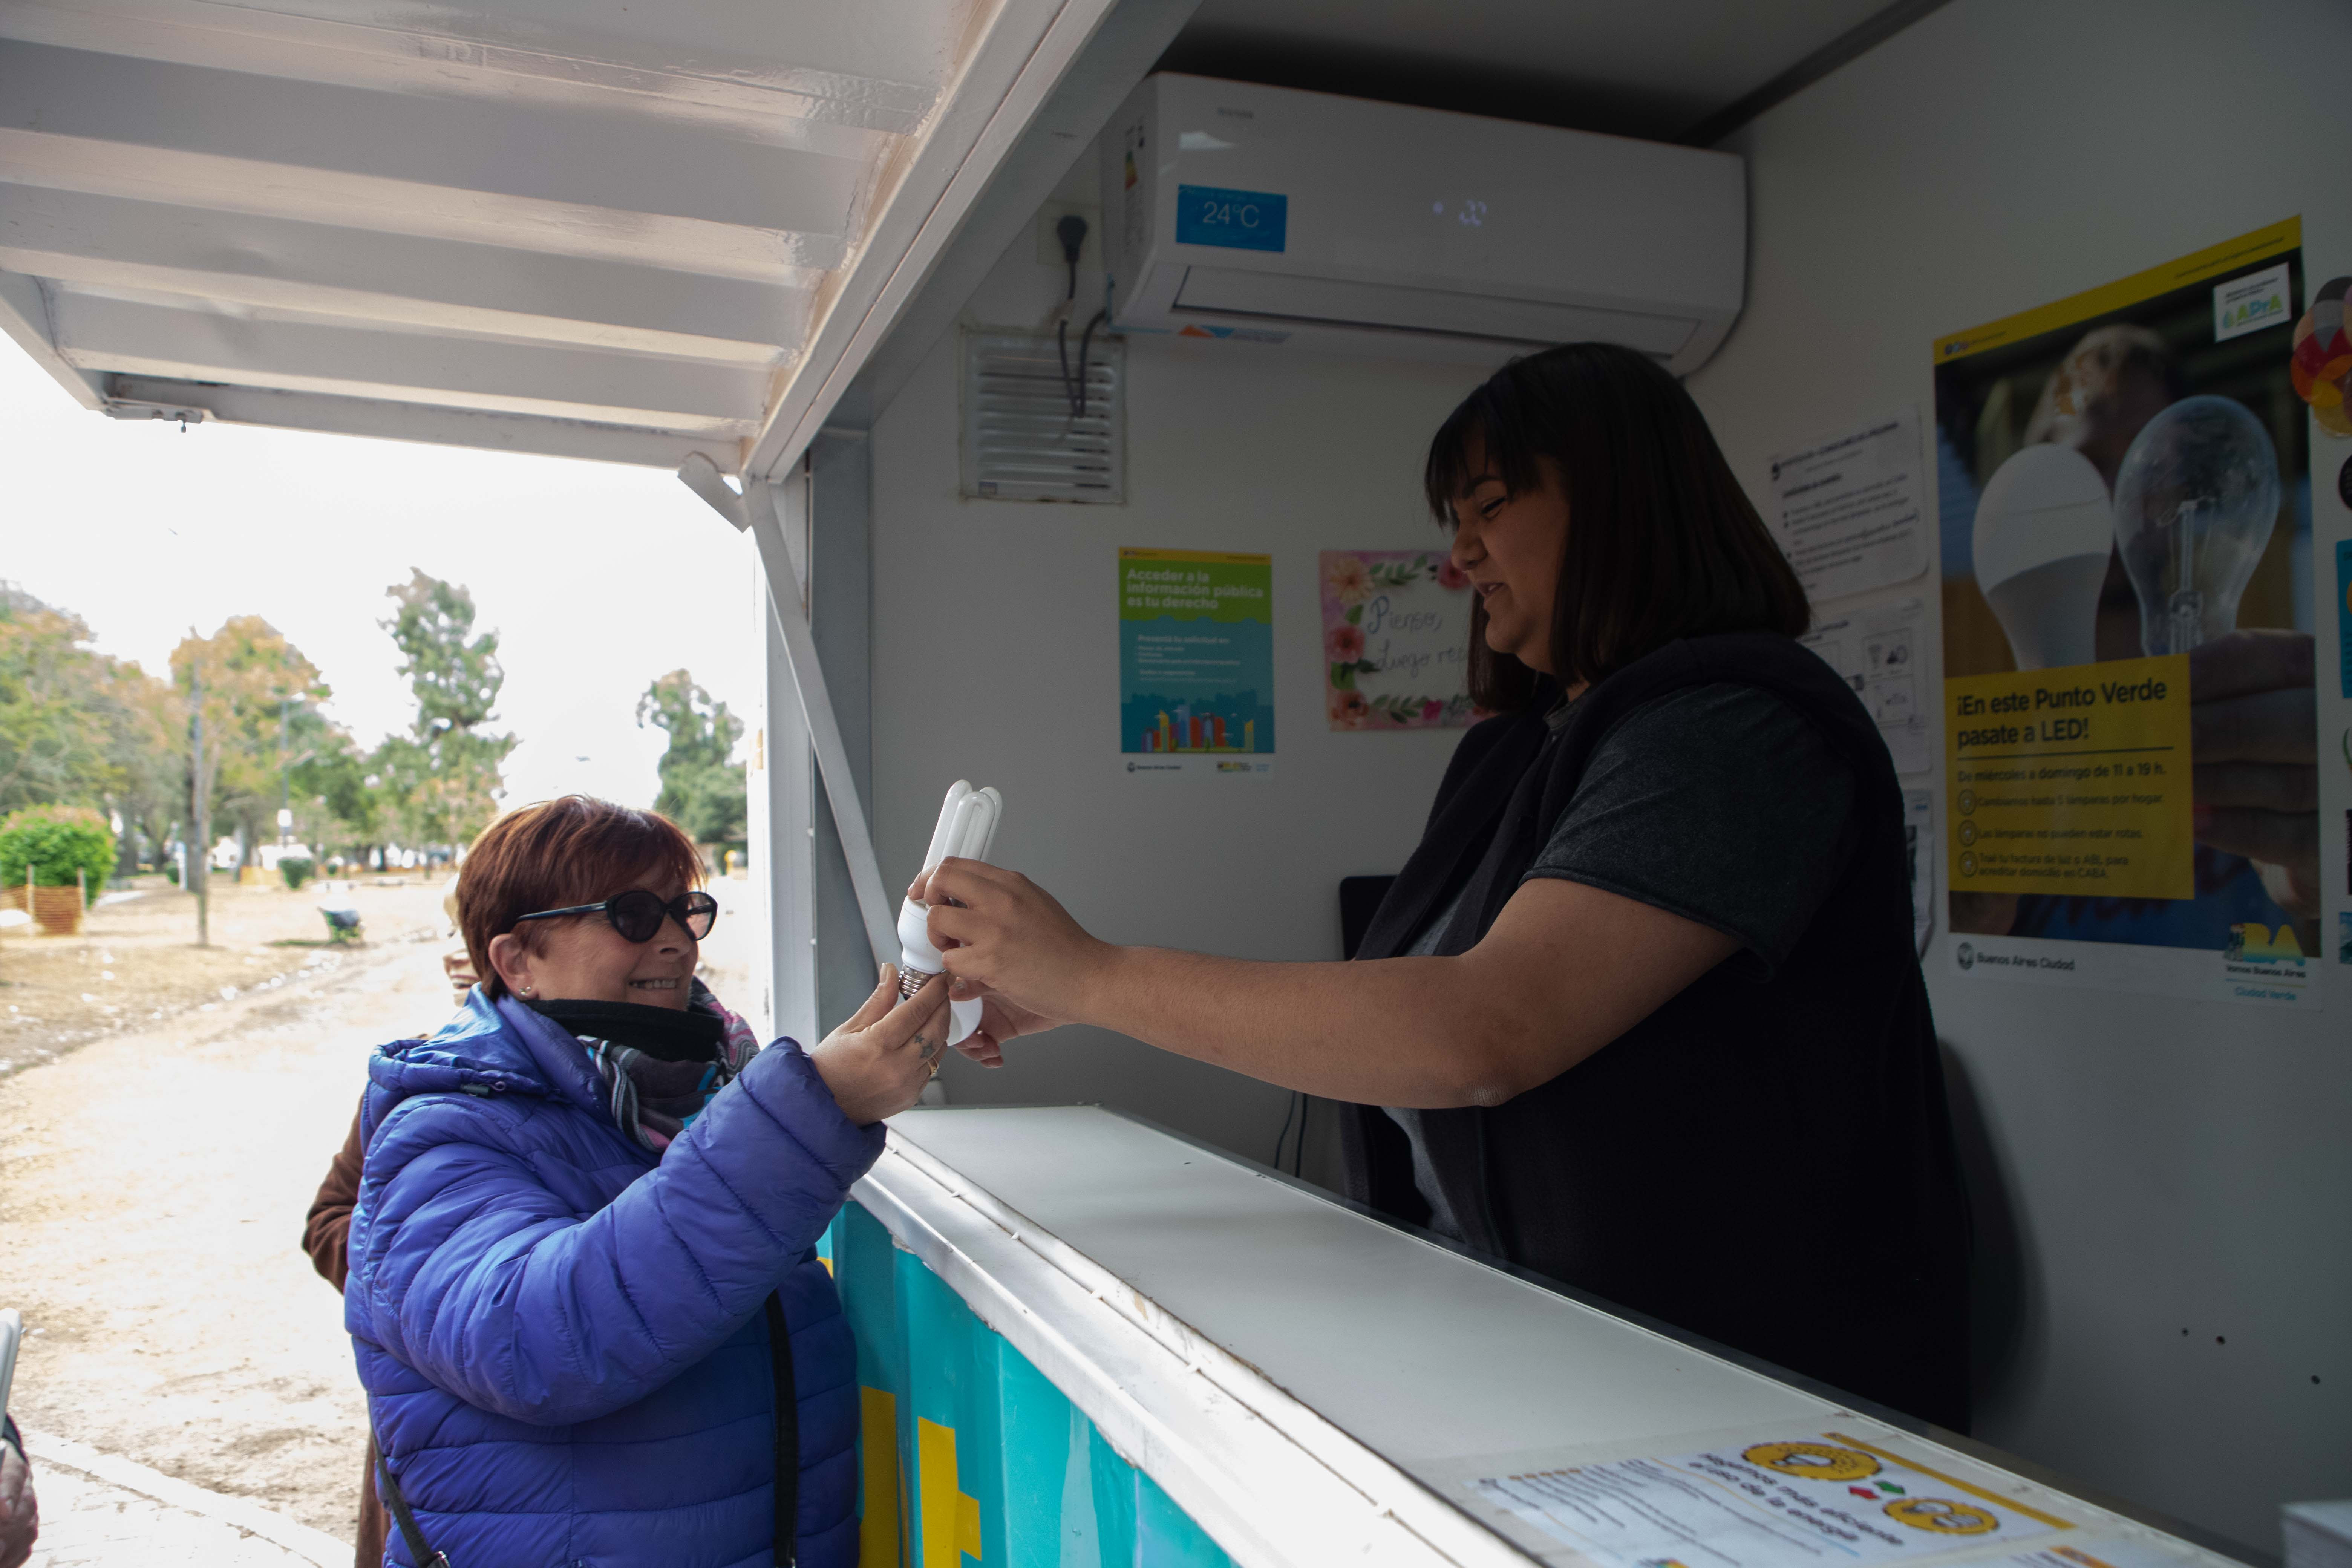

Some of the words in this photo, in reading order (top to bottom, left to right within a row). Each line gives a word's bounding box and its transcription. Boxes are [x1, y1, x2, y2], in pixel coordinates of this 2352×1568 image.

[1202, 200, 1260, 228] 24°C
[1126, 568, 1184, 582] Acceder
[1186, 572, 1195, 582] a
[1197, 570, 1210, 583] la
[1127, 581, 1210, 596] información
[1213, 585, 1263, 598] pública
[1127, 597, 1142, 606] es
[1145, 597, 1159, 607] tu
[1162, 596, 1219, 609] derecho
[1957, 694, 1985, 716] ¡En
[1991, 692, 2030, 713] este
[2035, 686, 2096, 709] Punto
[2100, 677, 2167, 704] Verde
[1958, 724, 2018, 751] pasate
[2024, 725, 2035, 742] a
[2041, 717, 2089, 741] LED!
[1958, 770, 1972, 782] De
[1975, 768, 2026, 781] miércoles
[2029, 770, 2035, 780] a
[2038, 766, 2091, 781] domingo
[2093, 764, 2109, 778] de
[2112, 763, 2123, 776] 11
[2127, 766, 2134, 776] a
[2138, 762, 2151, 776] 19
[2112, 795, 2129, 807] por
[2050, 828, 2087, 840] pueden
[1976, 951, 2010, 966] Buenos
[2012, 954, 2038, 969] Aires
[2039, 956, 2076, 972] Ciudad
[2234, 986, 2268, 998] Ciudad
[2268, 989, 2297, 1001] Verde
